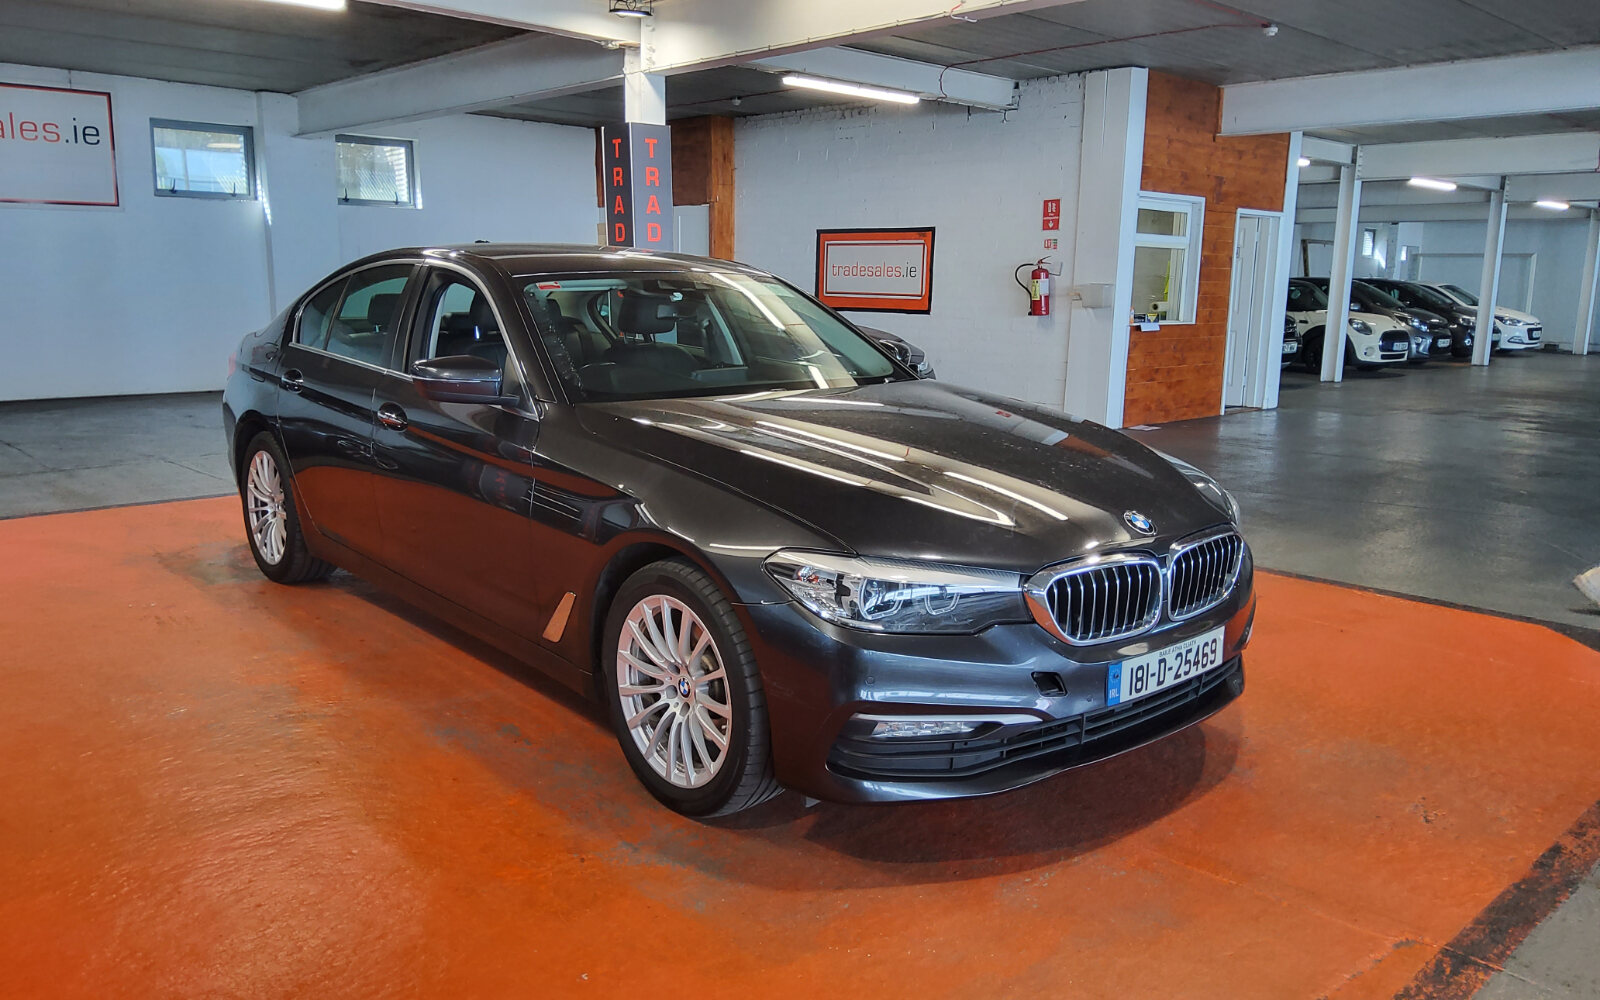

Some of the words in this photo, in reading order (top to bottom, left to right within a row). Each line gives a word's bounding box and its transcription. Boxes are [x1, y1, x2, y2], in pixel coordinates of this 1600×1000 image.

[0, 112, 101, 145] les.ie
[612, 138, 626, 242] TRAD
[644, 138, 662, 242] TRAD
[832, 261, 917, 278] tradesales.ie
[1129, 638, 1218, 695] 181-D-25469
[1109, 688, 1119, 699] IRL
